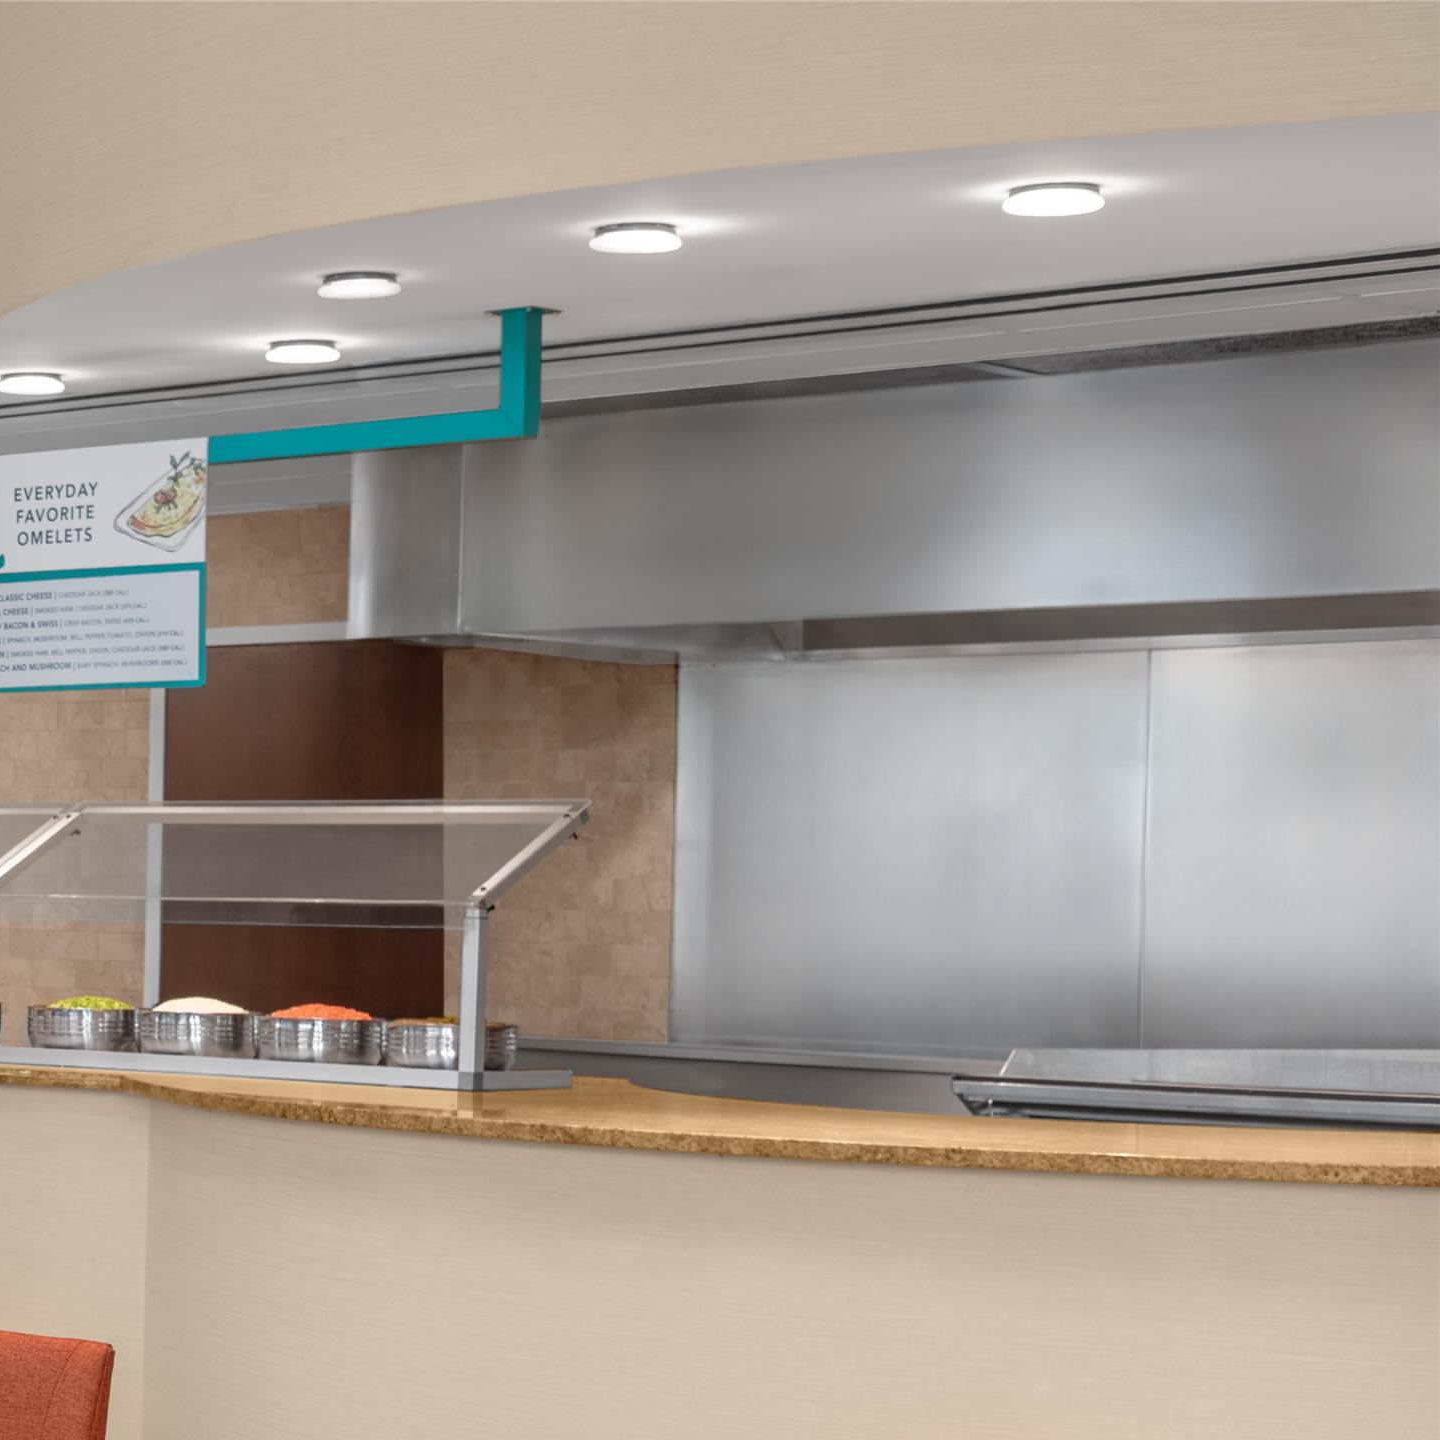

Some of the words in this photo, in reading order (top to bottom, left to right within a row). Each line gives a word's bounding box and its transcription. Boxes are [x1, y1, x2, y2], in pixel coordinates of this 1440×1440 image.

[14, 482, 98, 502] EVERYDAY
[16, 504, 95, 523] FAVORITE
[17, 527, 92, 546] OMELETS
[26, 592, 52, 601] CHEESE
[2, 607, 28, 616] CHEESE
[4, 621, 29, 630] BACON
[37, 620, 58, 628] SWISS
[11, 663, 27, 671] AND
[28, 661, 71, 671] MUSHROOM
